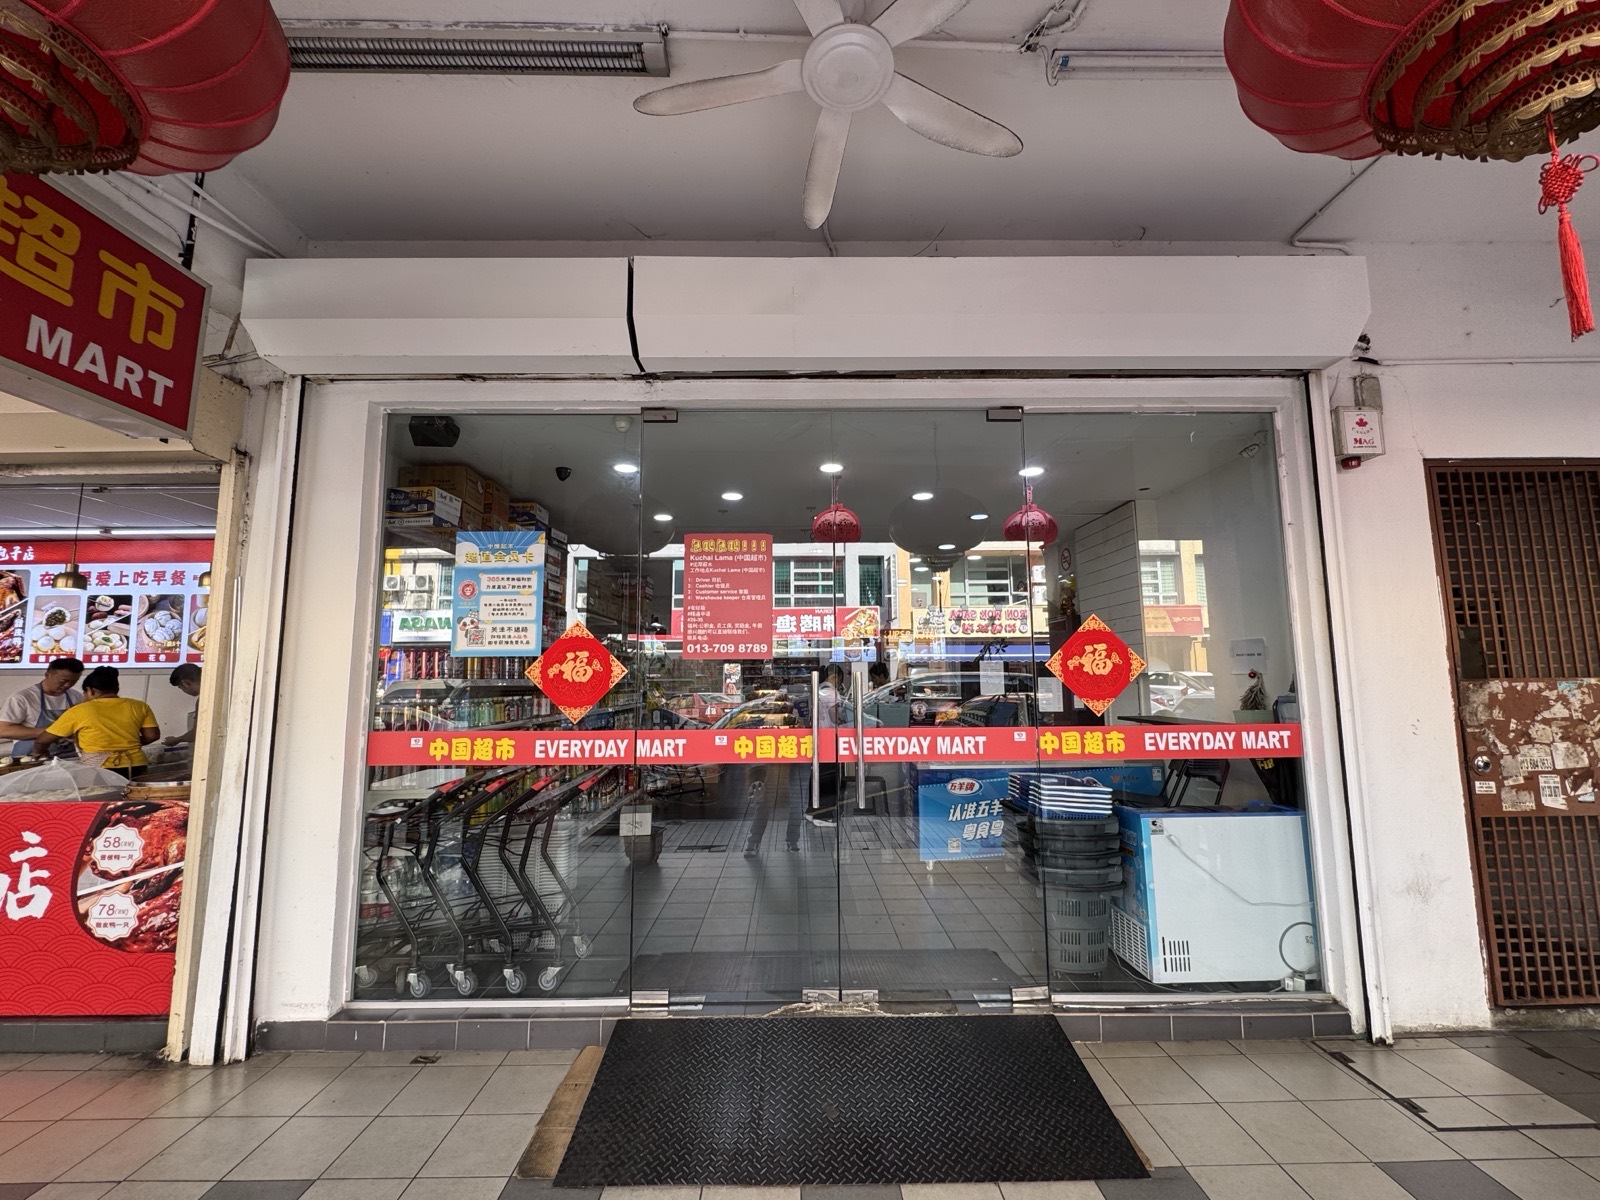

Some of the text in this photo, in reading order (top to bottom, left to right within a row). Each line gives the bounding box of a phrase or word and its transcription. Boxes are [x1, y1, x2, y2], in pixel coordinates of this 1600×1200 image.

[0, 174, 184, 350] 超市
[26, 314, 174, 408] MART
[687, 644, 767, 653] 013-709 8789
[1080, 643, 1113, 676] 福
[560, 651, 594, 682] 福
[428, 737, 516, 761] 中国超市
[535, 739, 629, 758] EVERYDAY
[636, 738, 686, 758] MART
[734, 735, 986, 759] 中国超市 EVERYDAY MART
[1040, 730, 1290, 755] 中国超市 EVERYDAY MART
[948, 798, 1013, 821] 认准五羊
[103, 836, 121, 848] 58
[0, 831, 53, 921] 店
[99, 904, 115, 916] 78
